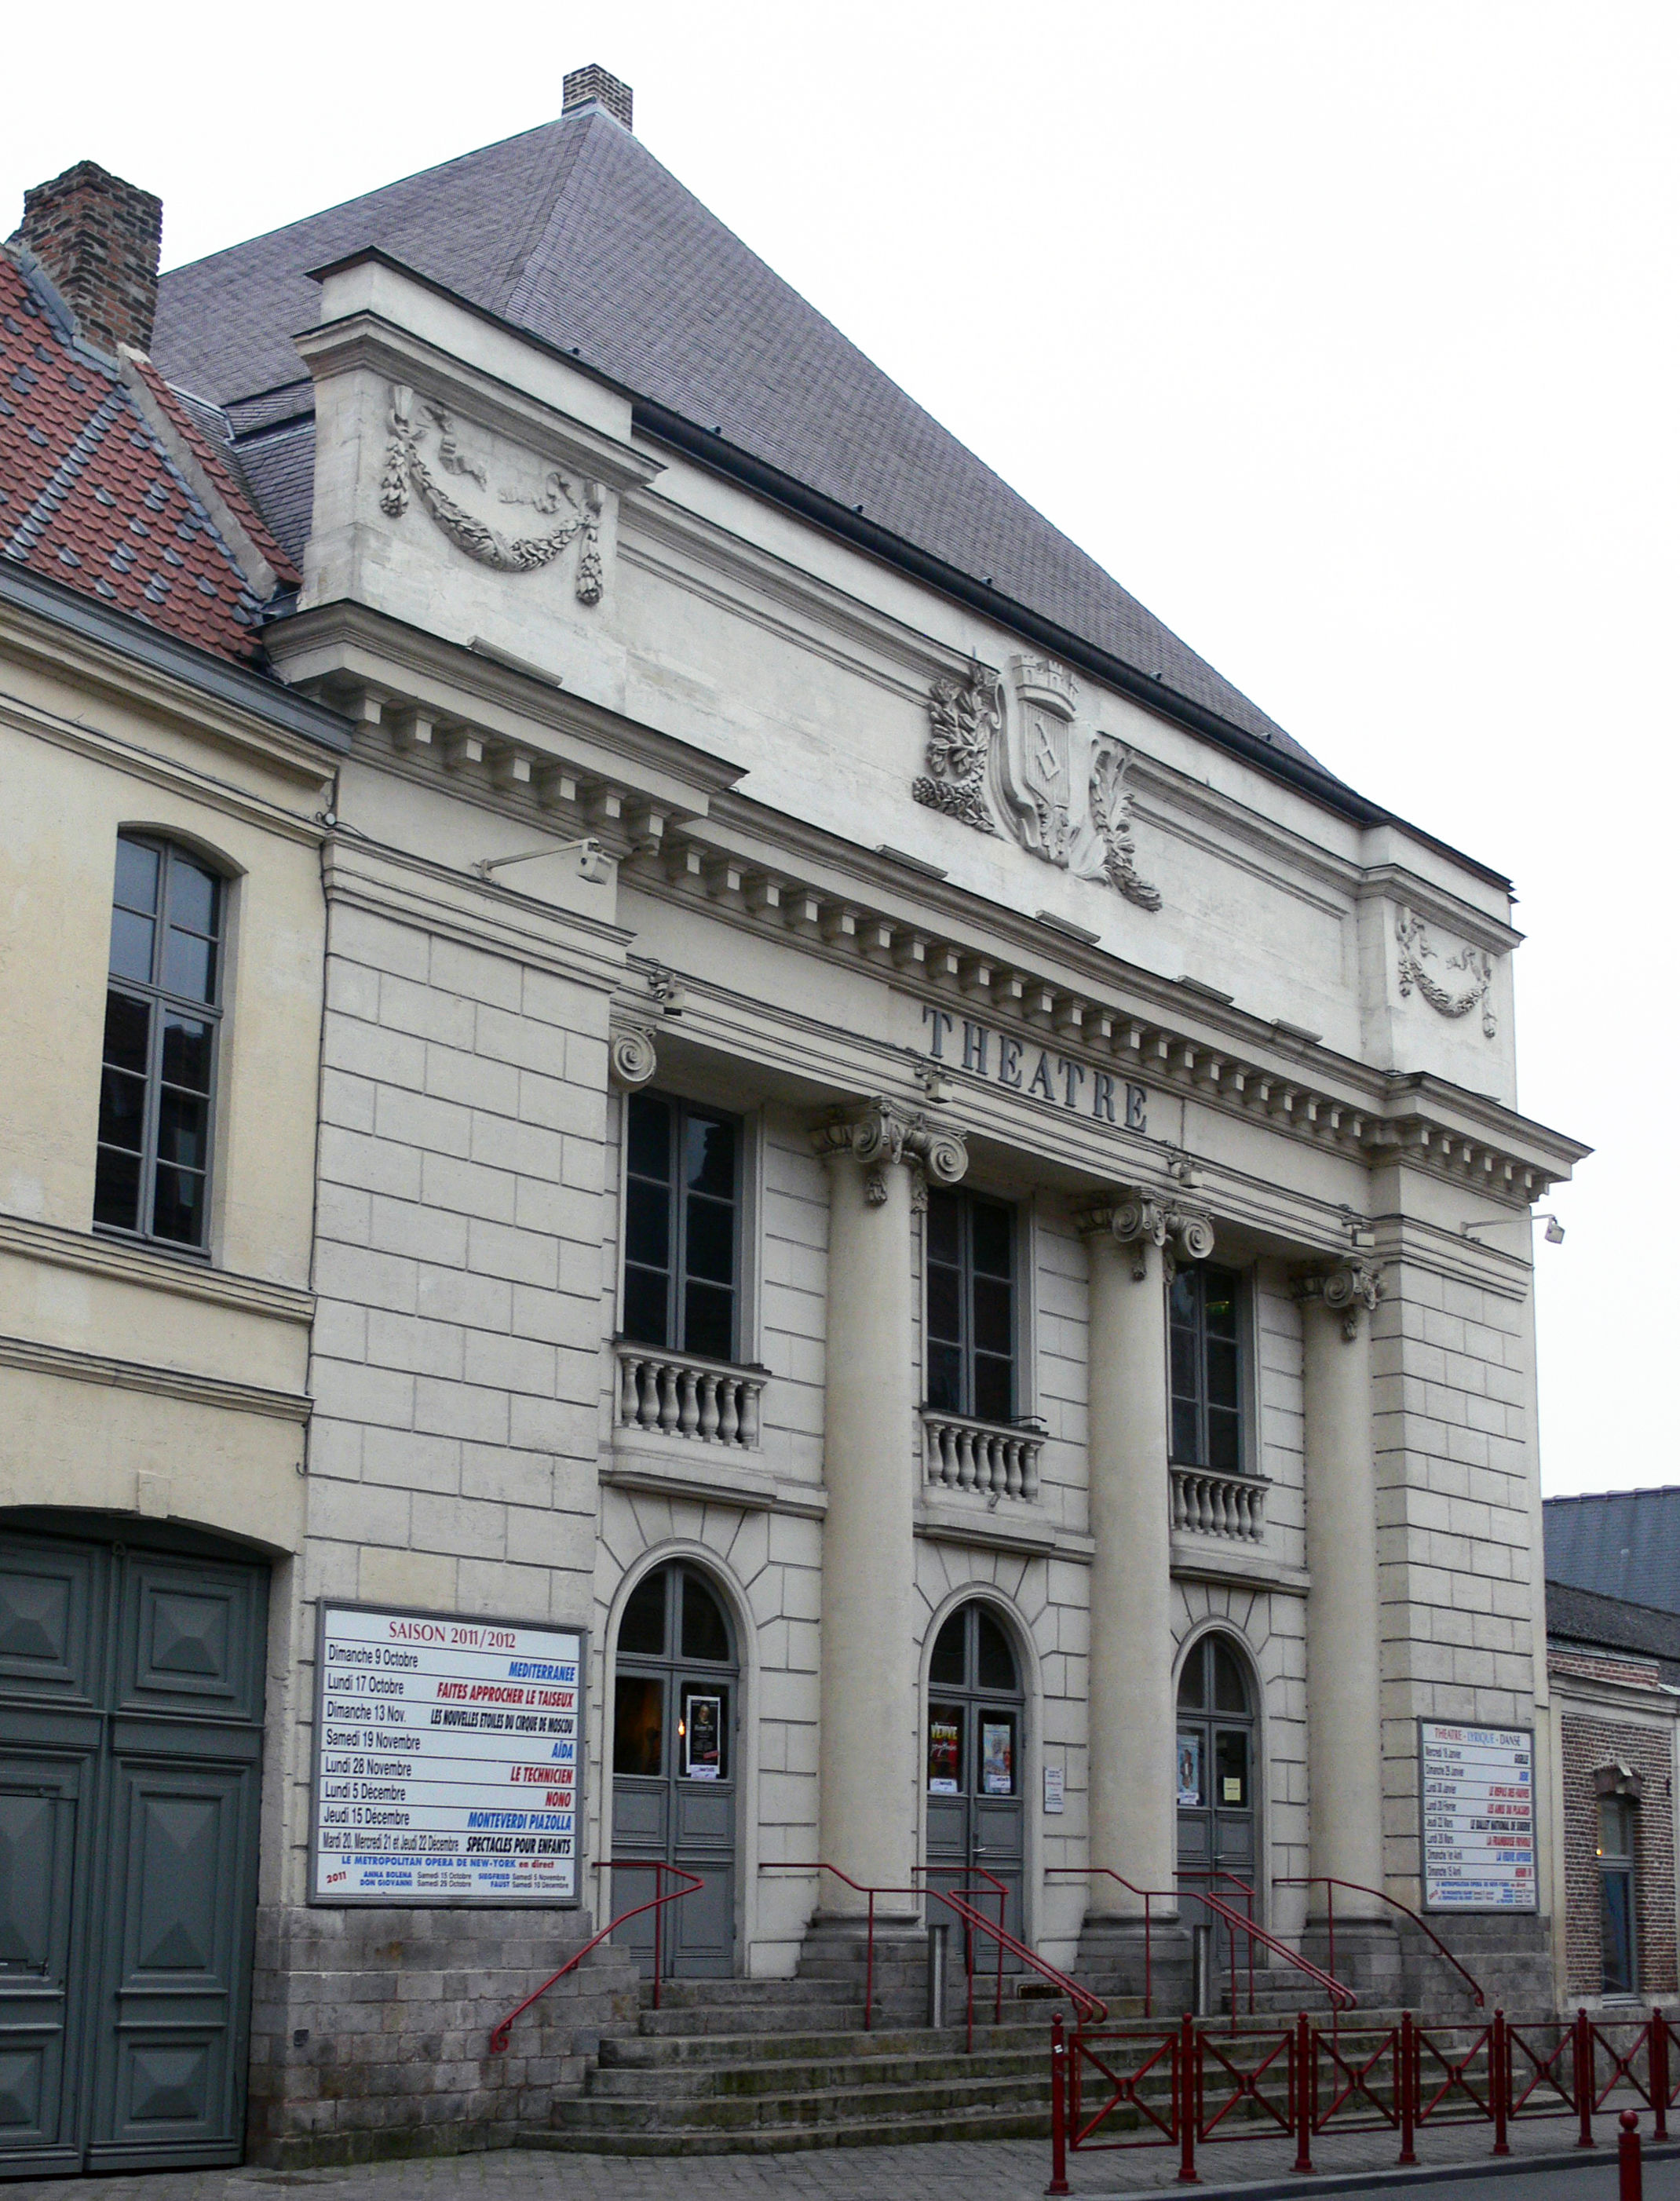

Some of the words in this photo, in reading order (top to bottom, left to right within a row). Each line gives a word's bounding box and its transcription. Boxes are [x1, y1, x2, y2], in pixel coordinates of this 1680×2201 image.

[922, 1006, 1148, 1133] THEATRE
[389, 1621, 446, 1643] SAISON
[451, 1628, 515, 1649] 2011/2012
[328, 1644, 373, 1665] Dimanche
[375, 1648, 381, 1663] 9
[384, 1649, 418, 1668] Octobre
[509, 1661, 575, 1681] MEDITERRANEE
[327, 1673, 353, 1691] Lundi
[356, 1675, 367, 1692] 17
[370, 1677, 404, 1695] Octobre
[436, 1682, 467, 1699] FAITES
[469, 1684, 524, 1703] APPROCHER
[526, 1689, 536, 1705] LE
[539, 1690, 573, 1708] TAISEUX
[327, 1702, 372, 1721] Dimanche
[374, 1706, 385, 1721] 13
[388, 1706, 406, 1723] Nov.
[430, 1709, 442, 1725] LES
[443, 1710, 478, 1728] NOUVELLES
[480, 1712, 503, 1729] ETOILES
[505, 1714, 513, 1729] DU
[516, 1715, 538, 1733] CIRQUE
[539, 1717, 546, 1732] DE
[548, 1717, 573, 1734] MOSCOU
[327, 1730, 360, 1747] Samedi
[363, 1732, 373, 1747] 19
[376, 1732, 420, 1750] Novembre
[1435, 1728, 1462, 1740] THEATRE
[1500, 1734, 1521, 1746] DANSE
[552, 1740, 572, 1758] AÏDA
[326, 1757, 350, 1773] Lundi
[352, 1758, 364, 1773] 28
[367, 1759, 411, 1776] Novembre
[511, 1766, 522, 1782] LE
[524, 1767, 572, 1783] TECHNICIEN
[326, 1782, 350, 1798] Lundi
[353, 1783, 359, 1798] 5
[361, 1783, 405, 1801] Décembre
[546, 1791, 571, 1807] NONO
[324, 1807, 349, 1823] Jeudi
[352, 1809, 362, 1823] 15
[365, 1808, 409, 1825] Décembre
[468, 1812, 527, 1828] MONTEVERDI
[529, 1813, 571, 1831] PIAZOLLA
[323, 1832, 341, 1849] Mardi
[355, 1834, 382, 1850] Mercredi
[384, 1834, 391, 1850] 21
[393, 1836, 399, 1850] et
[400, 1834, 417, 1850] Jeudi
[419, 1835, 425, 1851] 22
[428, 1834, 458, 1852] Décembre
[466, 1836, 512, 1853] SPECTACLES
[513, 1837, 536, 1853] POUR
[538, 1838, 571, 1854] ENFANTS
[341, 1856, 351, 1864] LE
[355, 1856, 422, 1866] METROPOLITAN
[327, 1871, 347, 1883] 2011
